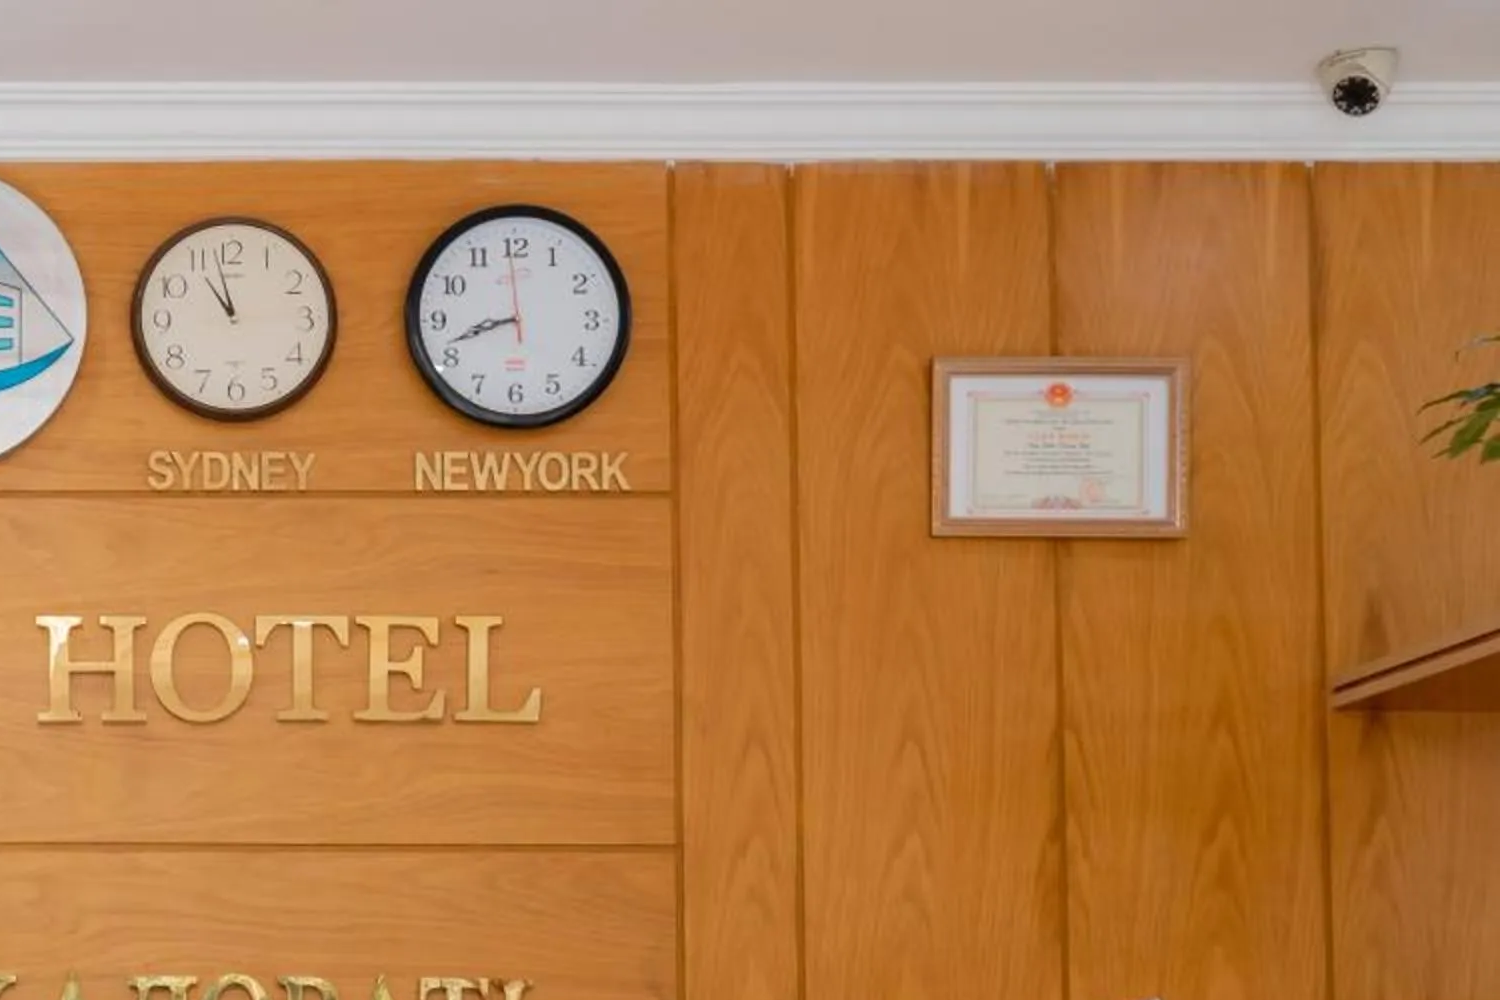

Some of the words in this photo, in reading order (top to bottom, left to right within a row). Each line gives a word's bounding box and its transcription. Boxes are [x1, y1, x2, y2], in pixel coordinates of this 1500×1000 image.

[221, 240, 243, 265] 12
[264, 248, 270, 269] 1
[469, 247, 488, 267] 11
[502, 238, 529, 258] 12
[548, 247, 557, 266] 1
[191, 248, 205, 271] 11
[162, 274, 187, 299] 10
[285, 270, 303, 295] 2
[443, 276, 466, 296] 10
[572, 274, 588, 294] 2
[153, 309, 171, 332] 9
[300, 306, 315, 332] 3
[431, 310, 446, 330] 9
[585, 310, 600, 330] 3
[166, 345, 185, 369] 8
[286, 342, 303, 364] 4
[442, 348, 459, 368] 8
[571, 346, 586, 366] 4
[195, 370, 211, 393] 7
[227, 379, 245, 401] 6
[261, 368, 278, 391] 5
[471, 375, 485, 395] 7
[545, 374, 561, 394] 5
[508, 383, 523, 403] 6
[148, 451, 316, 491] SYDNEY
[415, 451, 631, 491] NEWYORK
[35, 612, 542, 724] HOTEL
